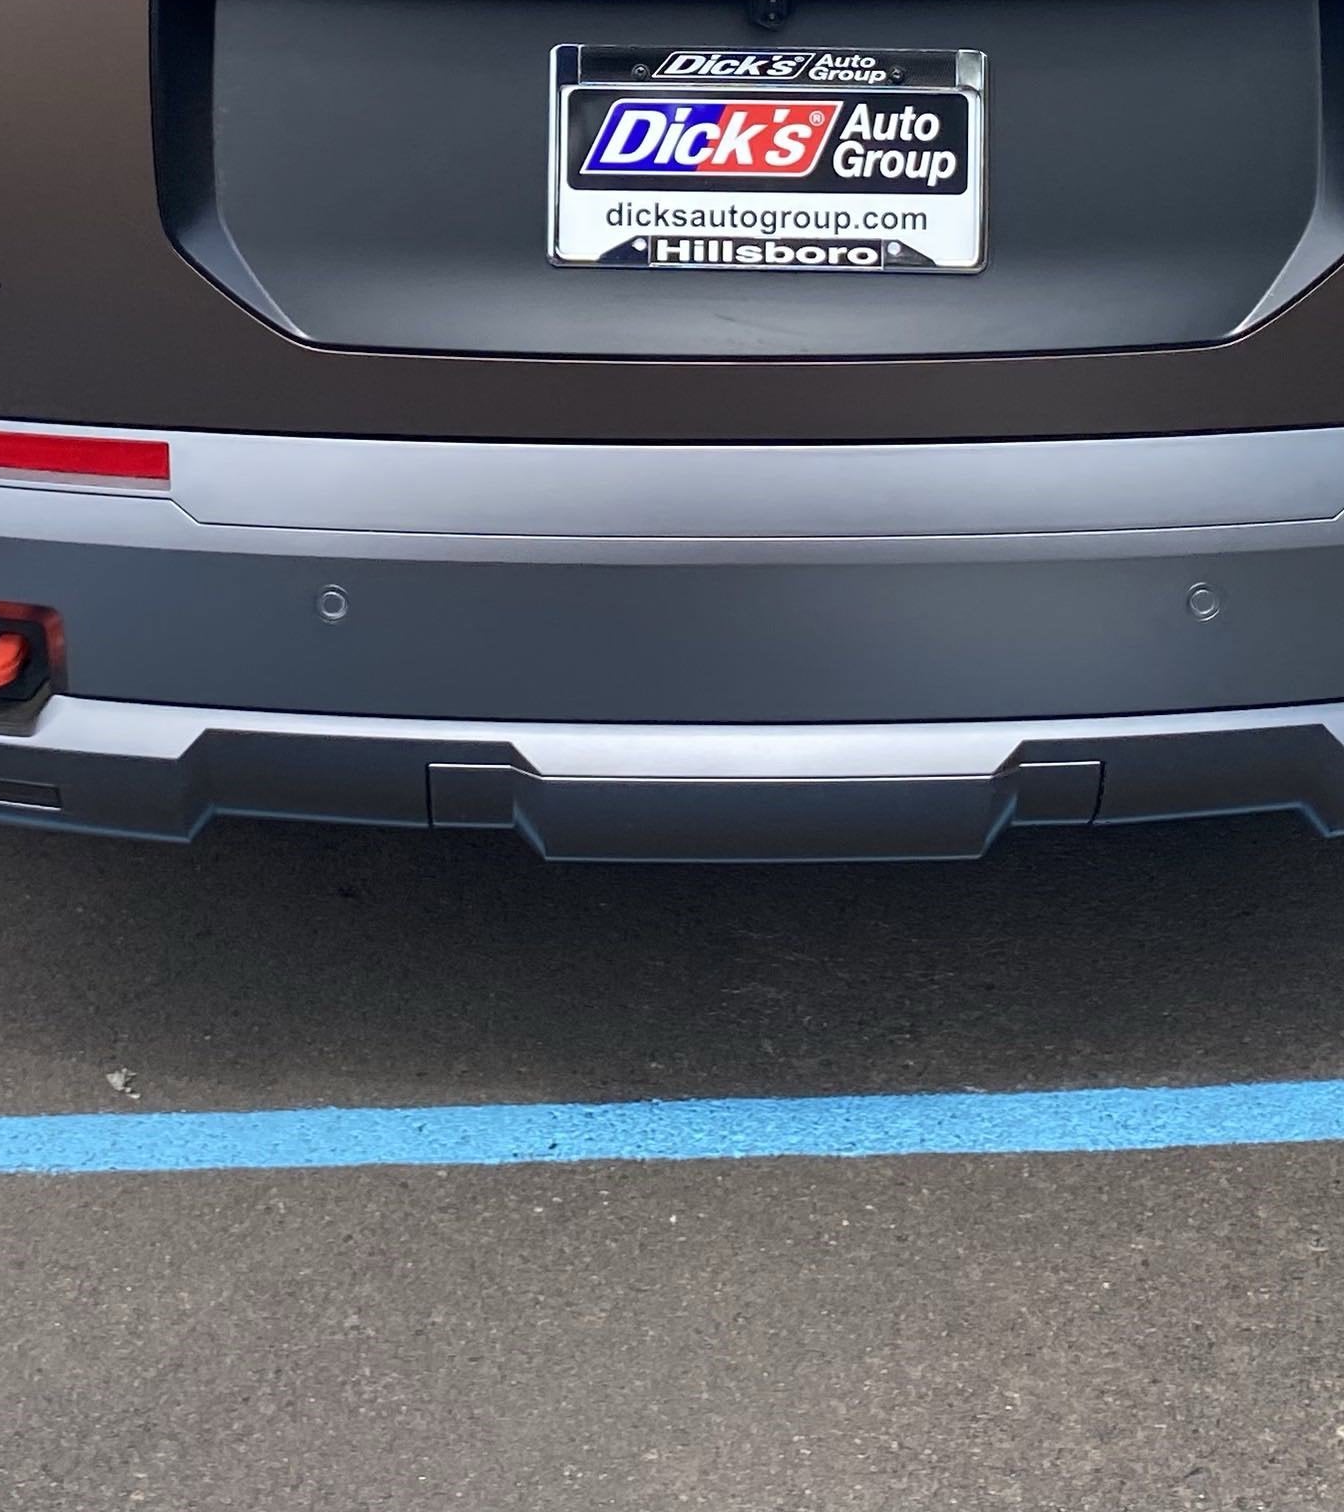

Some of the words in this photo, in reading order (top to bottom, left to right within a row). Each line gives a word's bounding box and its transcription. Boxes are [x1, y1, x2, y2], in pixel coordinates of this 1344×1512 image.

[663, 53, 800, 76] Dick's
[814, 53, 876, 69] Auto
[808, 66, 887, 84] Group
[599, 107, 812, 166] Dick's
[840, 103, 940, 142] Auto
[832, 141, 957, 186] Group
[605, 201, 928, 235] dicksautogroup.com
[656, 239, 881, 265] Hillsboro
